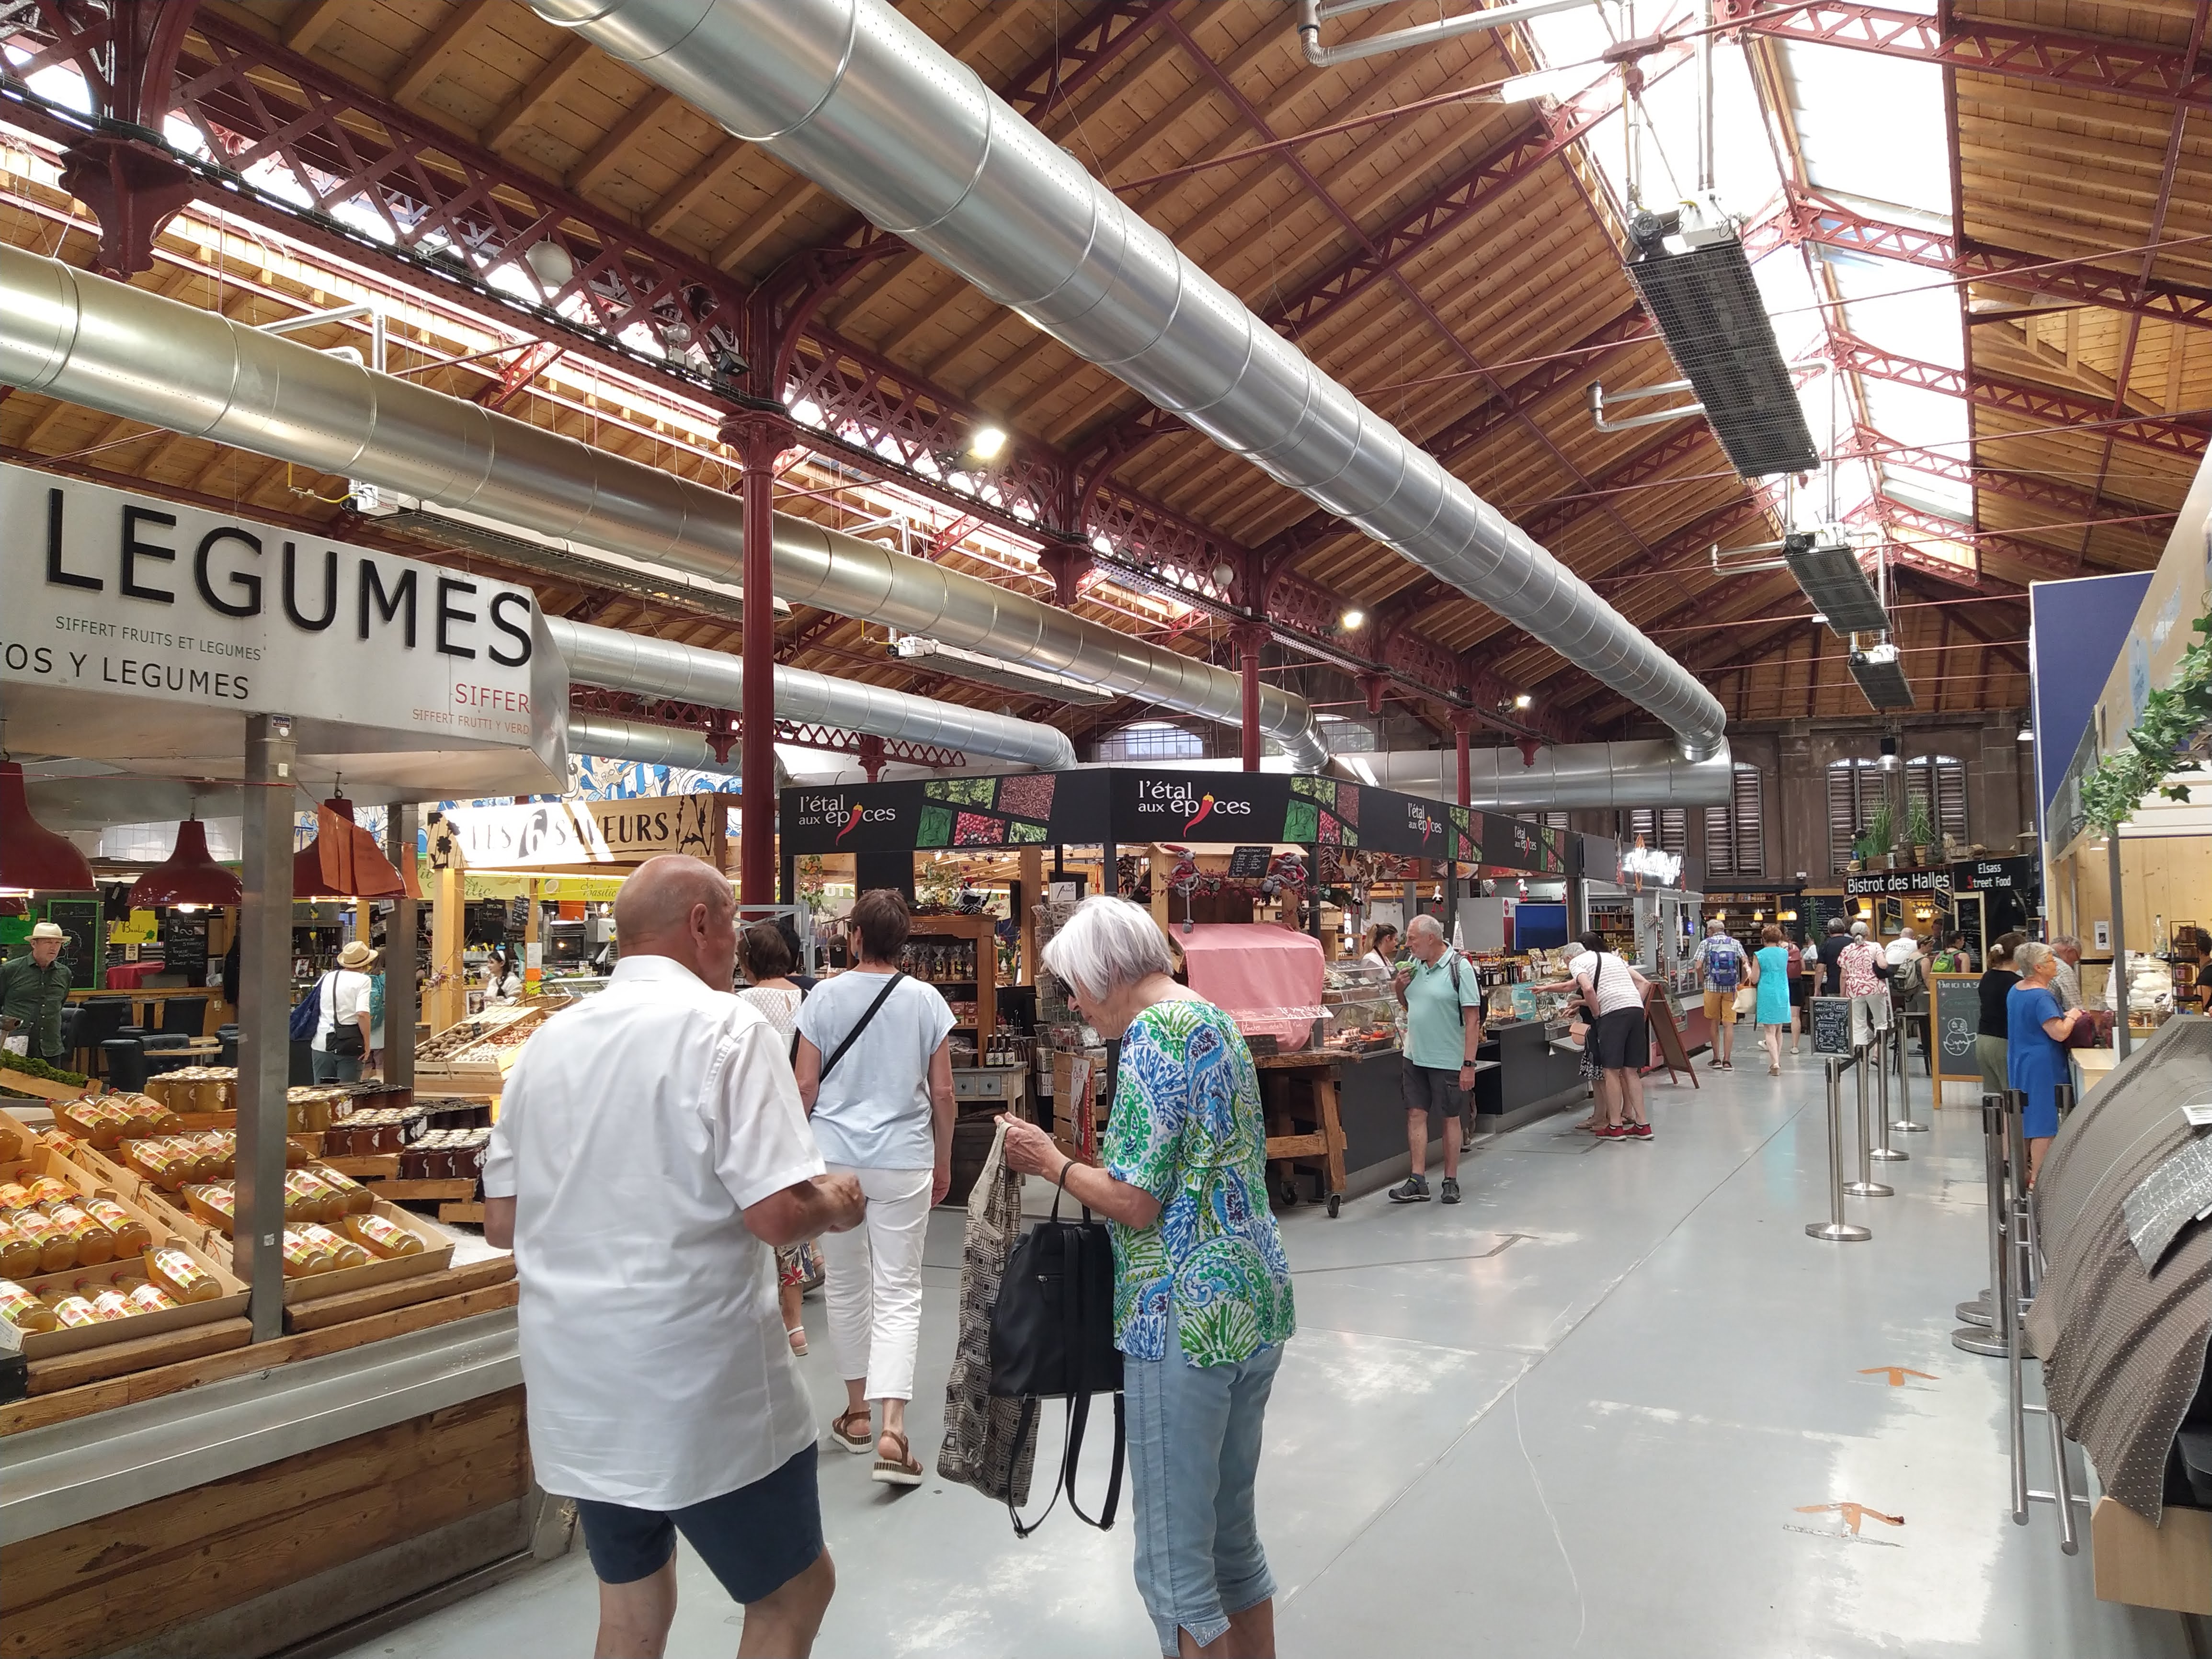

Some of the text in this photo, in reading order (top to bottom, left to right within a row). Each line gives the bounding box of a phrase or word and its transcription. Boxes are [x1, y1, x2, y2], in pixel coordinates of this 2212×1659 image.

[48, 488, 532, 667] LEGUMES
[55, 616, 261, 660] SIFFERT FRUITS ET LEGUMES
[69, 651, 87, 677] Y
[103, 657, 249, 700] LEGUMES
[455, 683, 530, 714] SIFFER
[412, 709, 529, 735] SIFFERT FRUTTI Y VERD
[1139, 780, 1192, 800] l'étal
[799, 794, 844, 813] l'étal
[1138, 803, 1165, 812] aux
[1408, 803, 1425, 819] l'étal
[798, 816, 821, 825] aux
[1408, 821, 1417, 830] aux
[1977, 863, 2002, 874] Elsass
[1847, 871, 1950, 894] Bistrot des Halles
[1995, 875, 2011, 887] Food
